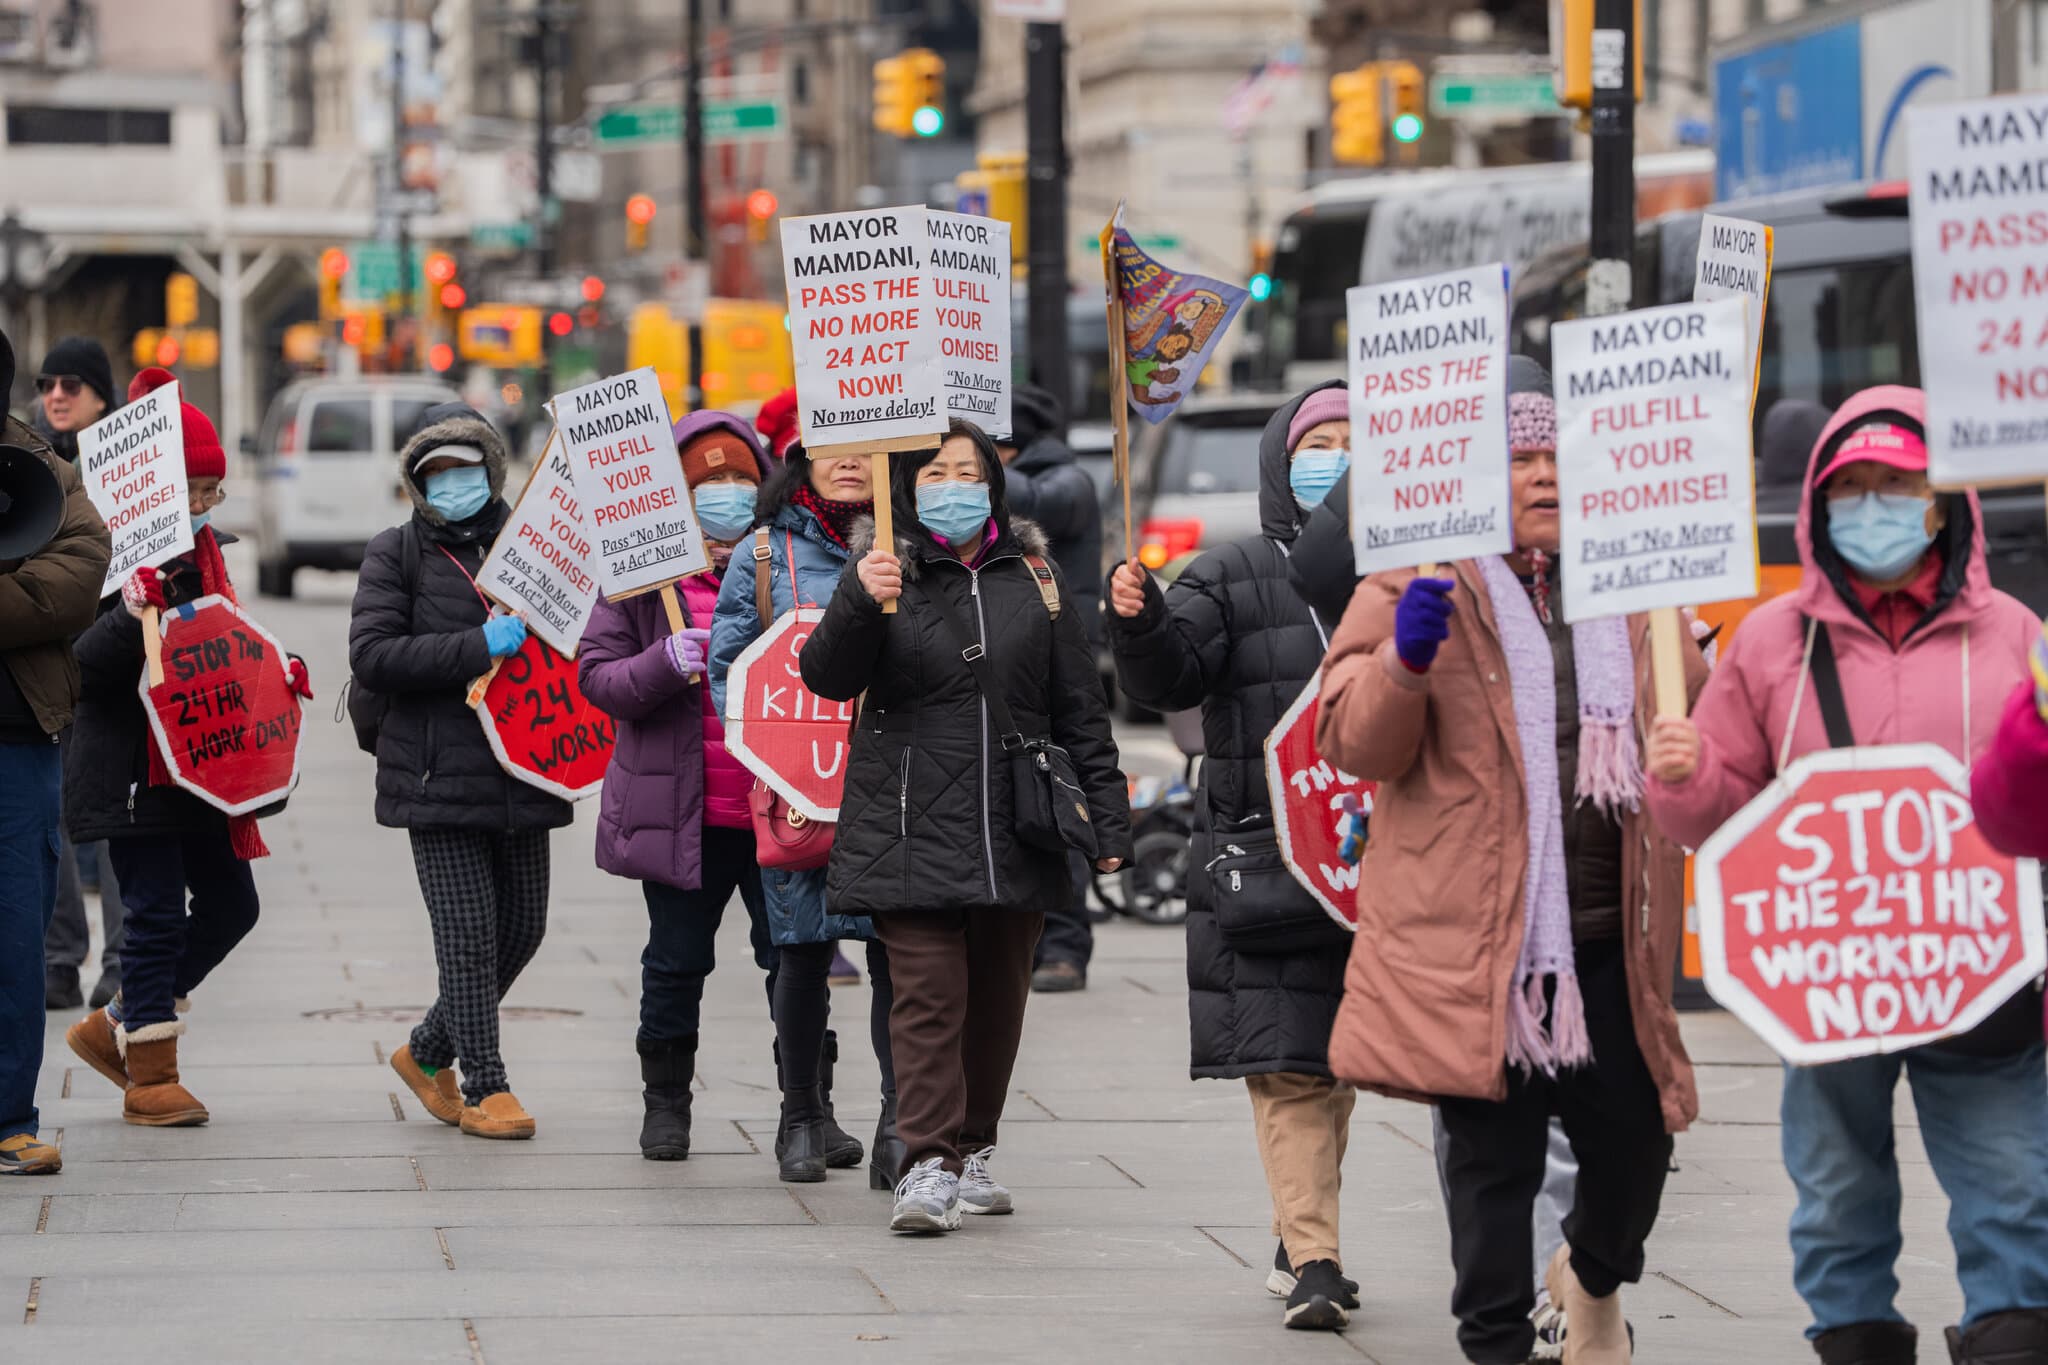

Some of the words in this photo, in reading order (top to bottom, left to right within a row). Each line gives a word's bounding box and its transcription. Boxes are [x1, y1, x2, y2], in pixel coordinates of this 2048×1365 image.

[809, 216, 898, 244] MAYOR
[927, 219, 989, 245] MAYOR
[1713, 225, 1756, 256] MAYOR
[794, 246, 920, 277] MAMDANI,
[930, 248, 1001, 281] AMDANI,
[1701, 260, 1759, 299] MAMDANI,
[801, 282, 866, 308] PASS
[873, 276, 920, 301] THE
[933, 277, 990, 303] ULFILL
[1379, 280, 1473, 319] MAYOR
[1951, 266, 2008, 304] NO
[809, 316, 843, 340] NO
[851, 308, 920, 336] MORE
[936, 307, 982, 331] YOUR
[1591, 313, 1705, 354] MAYOR
[1977, 318, 2022, 353] 24
[826, 347, 854, 370] 24
[860, 341, 910, 366] ACT
[940, 337, 999, 363] OMISE!
[1359, 317, 1495, 361] MAMDANI,
[838, 374, 903, 400] NOW!
[972, 373, 1002, 391] More
[1364, 365, 1431, 398] PASS
[1441, 355, 1490, 387] THE
[1569, 350, 1731, 399] MAMDANI,
[576, 378, 639, 414] MAYOR
[812, 408, 836, 425] No
[840, 405, 882, 420] more
[886, 397, 935, 418] delay!
[967, 393, 997, 413] Now!
[1591, 394, 1710, 435] FULFILL
[98, 398, 157, 443] MAYOR
[569, 403, 660, 445] MAMDANI,
[1369, 409, 1403, 438] NO
[1410, 395, 1485, 431] MORE
[1951, 421, 1991, 448] No
[88, 415, 173, 472] MAMDANI,
[587, 434, 655, 470] FULFILL
[1382, 447, 1411, 475] 24
[1418, 437, 1472, 468] ACT
[1609, 437, 1694, 473] YOUR
[101, 444, 163, 489] FULFILL
[603, 464, 653, 494] YOUR
[112, 470, 156, 505] YOUR
[594, 486, 678, 527] PROMISE!
[1394, 479, 1463, 511] NOW!
[1581, 473, 1729, 520] PROMISE!
[105, 484, 175, 533] ROMISE!
[151, 511, 179, 533] More
[1367, 526, 1389, 546] No
[1394, 521, 1436, 540] more
[1440, 506, 1496, 535] delay!
[147, 527, 177, 554] Now!
[548, 513, 591, 561] YOUR
[601, 537, 629, 554] Pass
[655, 519, 686, 538] More
[612, 560, 626, 574] 24
[655, 537, 686, 560] Now!
[1582, 537, 1626, 561] Pass
[1677, 522, 1734, 546] More
[517, 523, 594, 596] PROMISE!
[1591, 572, 1614, 592] 24
[1668, 548, 1727, 578] Now!
[498, 569, 515, 586] 24
[540, 599, 570, 634] Now!
[502, 547, 533, 574] Pass
[553, 588, 582, 618] More
[171, 636, 231, 681] STOP
[231, 629, 264, 661] THE
[169, 688, 212, 727] 24
[215, 681, 249, 716] HR
[496, 693, 520, 725] THE
[525, 677, 575, 732] 24
[186, 724, 247, 769] WORK
[256, 708, 299, 749] DAY!
[1776, 787, 1975, 885] STOP
[1731, 878, 1840, 937] THE
[1844, 869, 1924, 928] 24
[1933, 865, 2009, 931] HR
[1752, 931, 2011, 989] WORKDAY
[1805, 976, 1965, 1040] NOW
